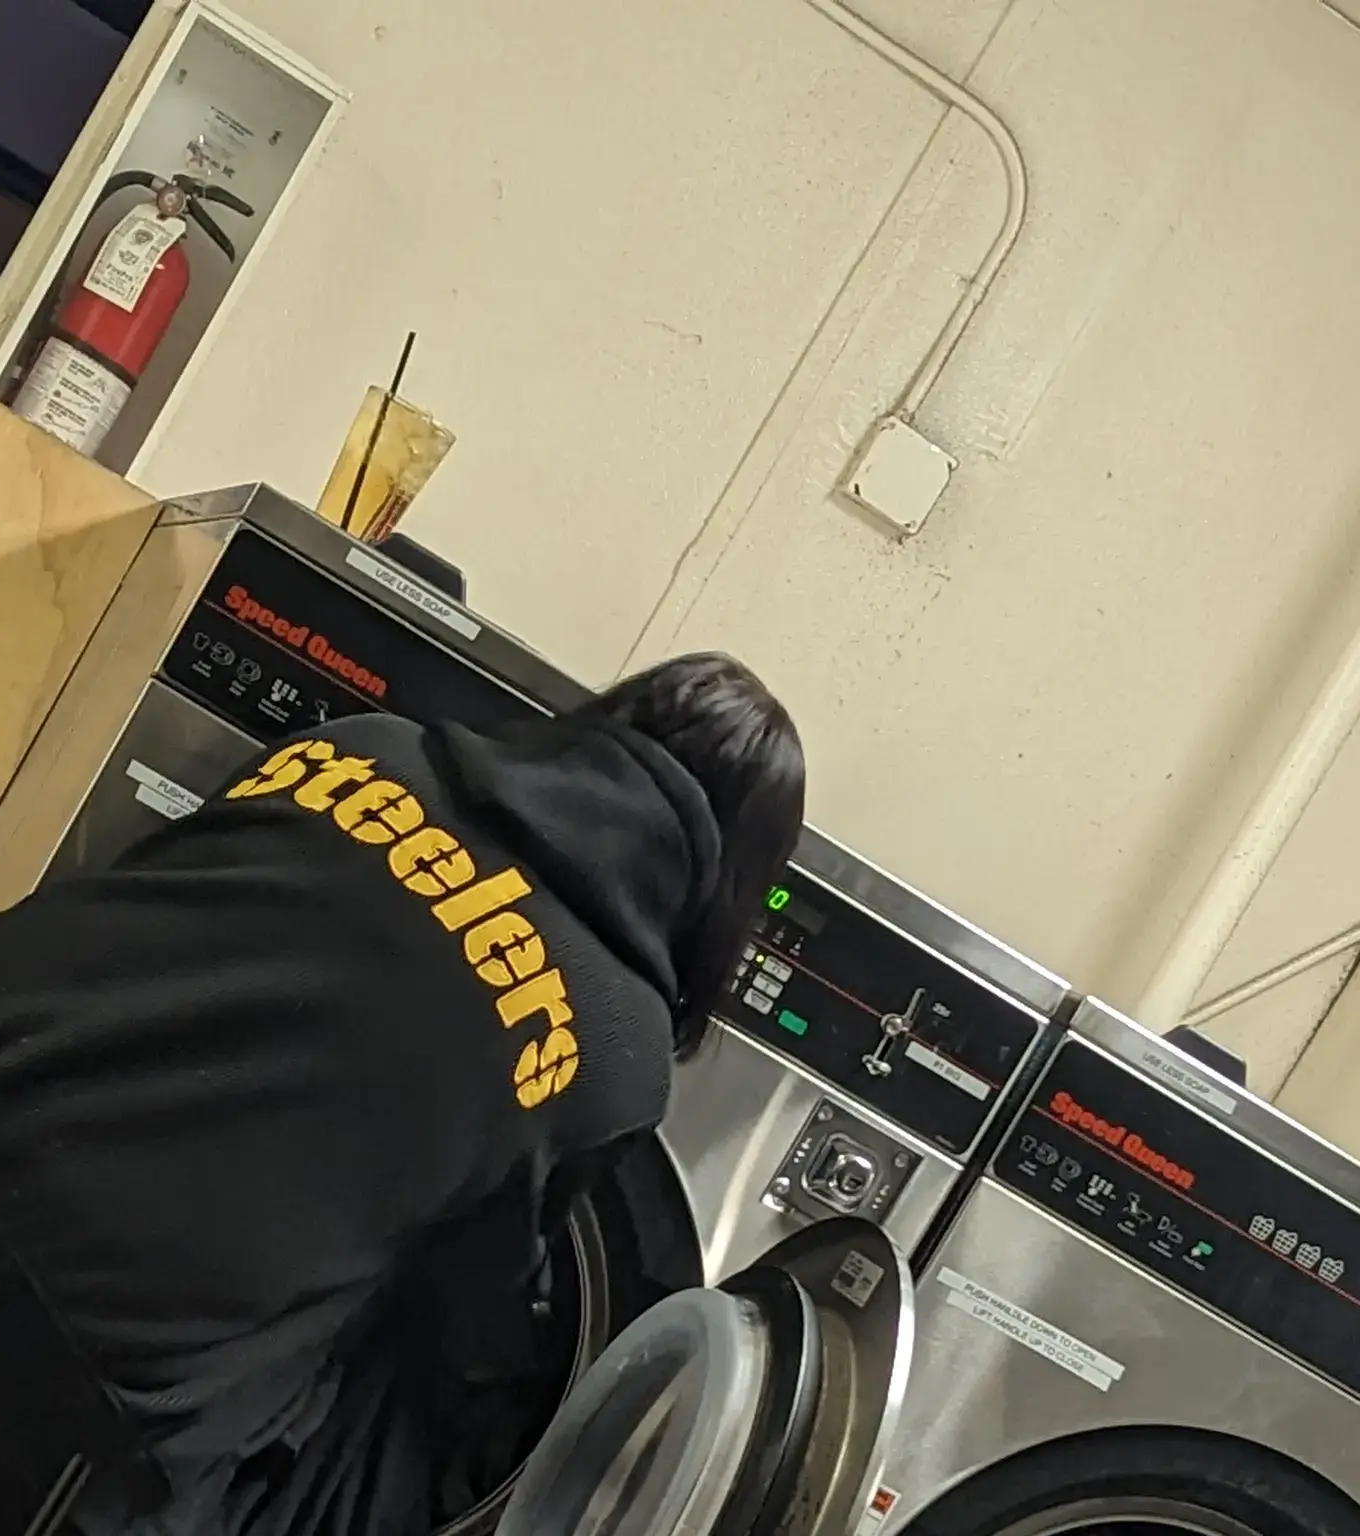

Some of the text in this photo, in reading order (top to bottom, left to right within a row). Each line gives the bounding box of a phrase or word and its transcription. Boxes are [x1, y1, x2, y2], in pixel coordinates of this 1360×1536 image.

[374, 567, 451, 619] USE LESS SOAP
[226, 585, 307, 647] Speed
[308, 633, 388, 698] Queen
[1050, 1092, 1195, 1190] Speed Queen
[963, 1281, 990, 1303] PUSH
[1029, 1319, 1058, 1341] DOWN
[1057, 1336, 1072, 1348] TO
[1070, 1342, 1097, 1362] OPEN
[971, 1303, 993, 1321] LIFT
[1027, 1335, 1042, 1349] UP
[1041, 1343, 1056, 1357] TO
[1053, 1350, 1084, 1373] CLOSE
